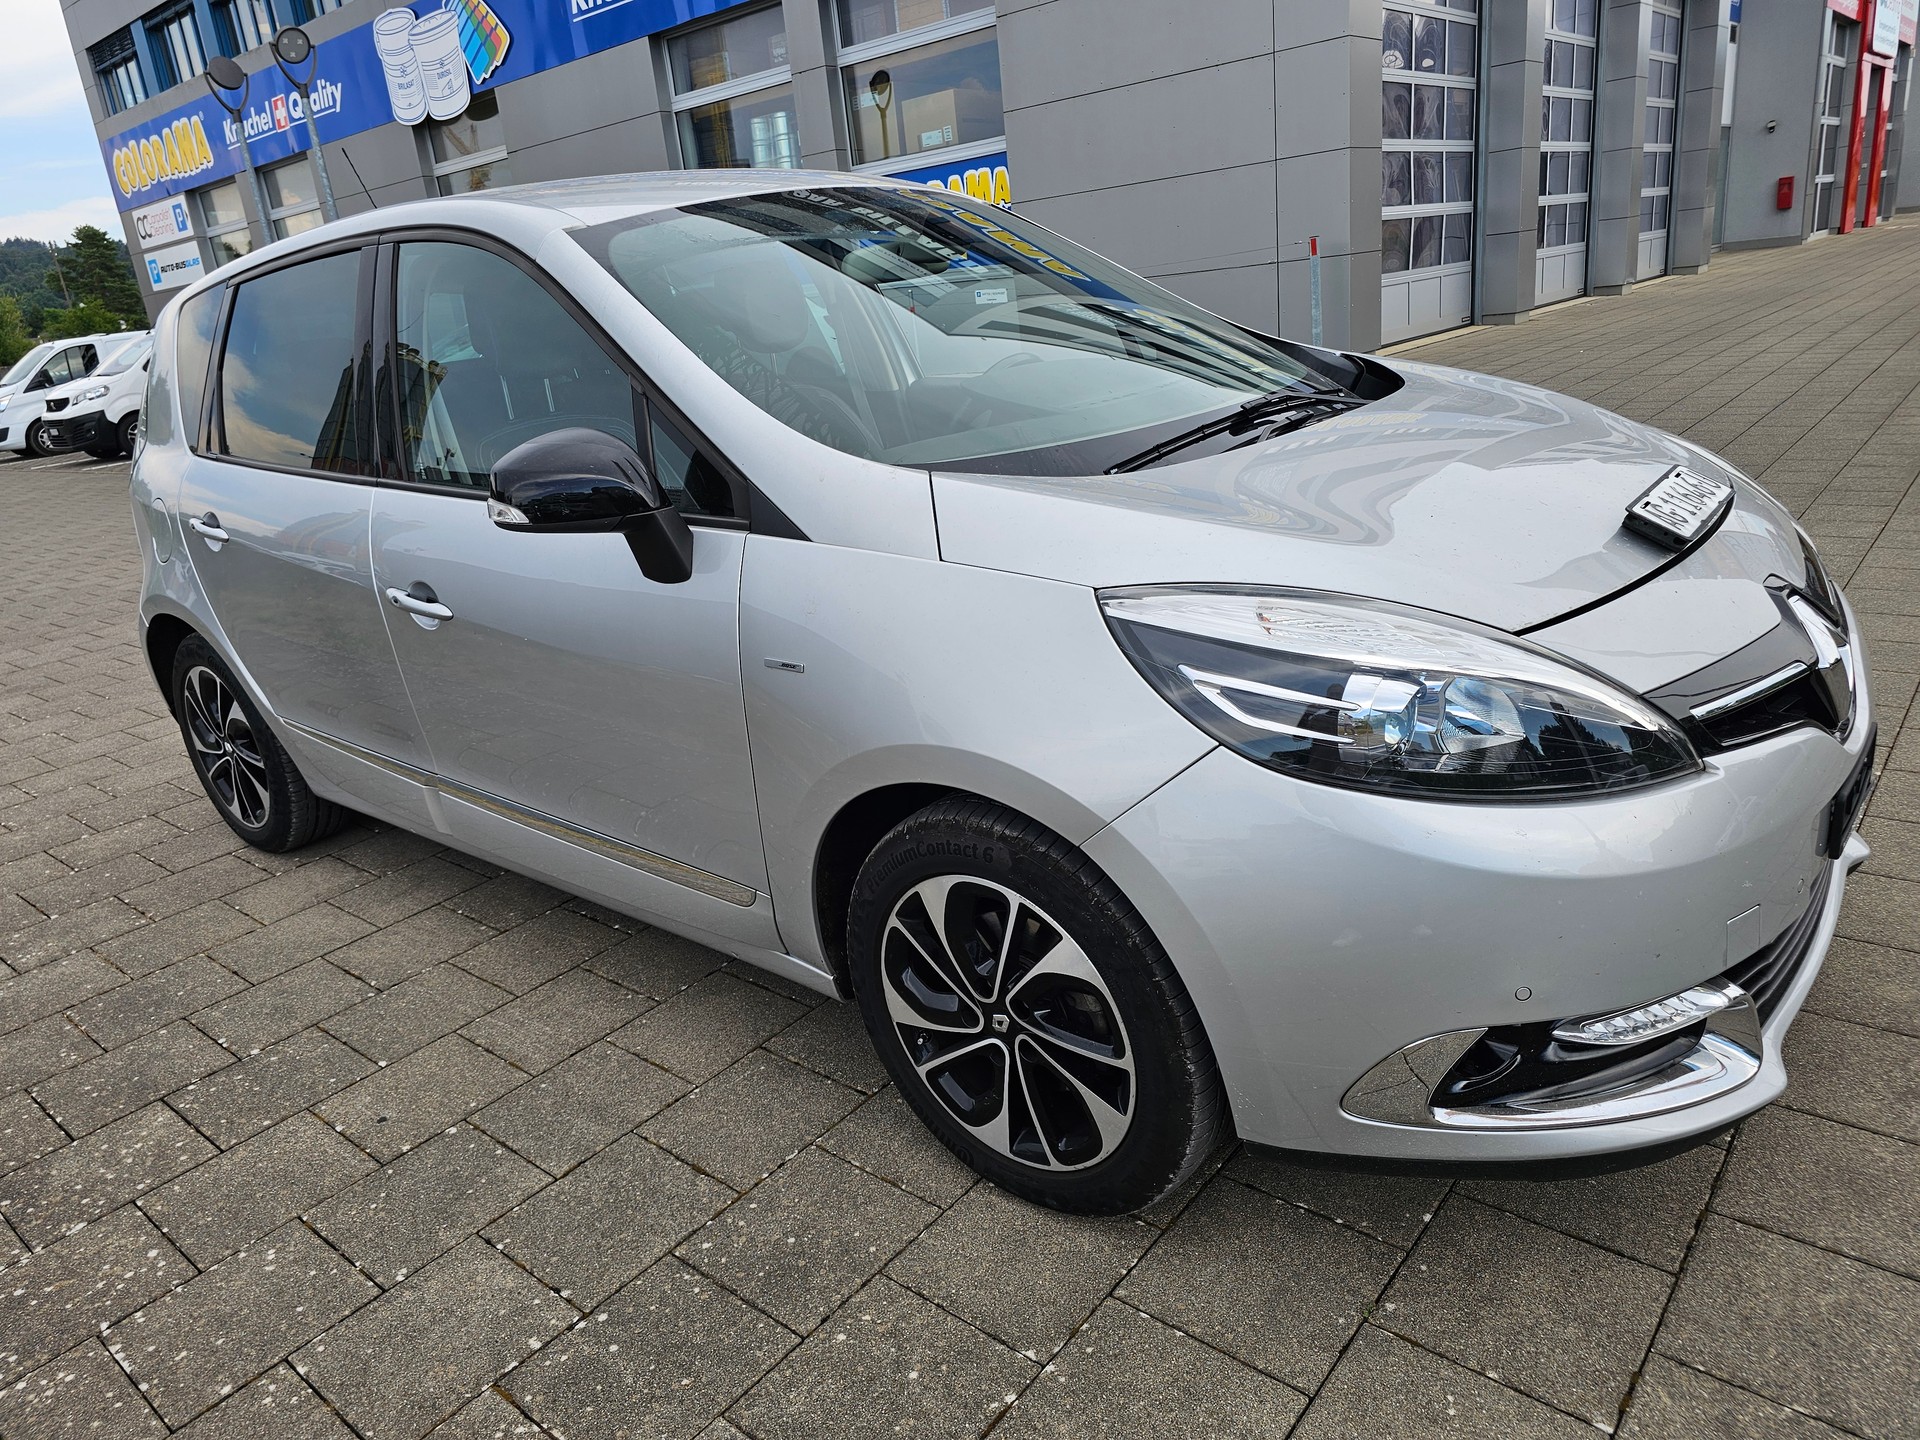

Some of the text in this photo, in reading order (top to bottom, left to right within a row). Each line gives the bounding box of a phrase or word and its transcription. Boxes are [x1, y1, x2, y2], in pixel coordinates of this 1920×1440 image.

[289, 79, 342, 120] Qality
[113, 115, 214, 199] COLORAMA
[866, 839, 995, 894] PremiumContact 6
